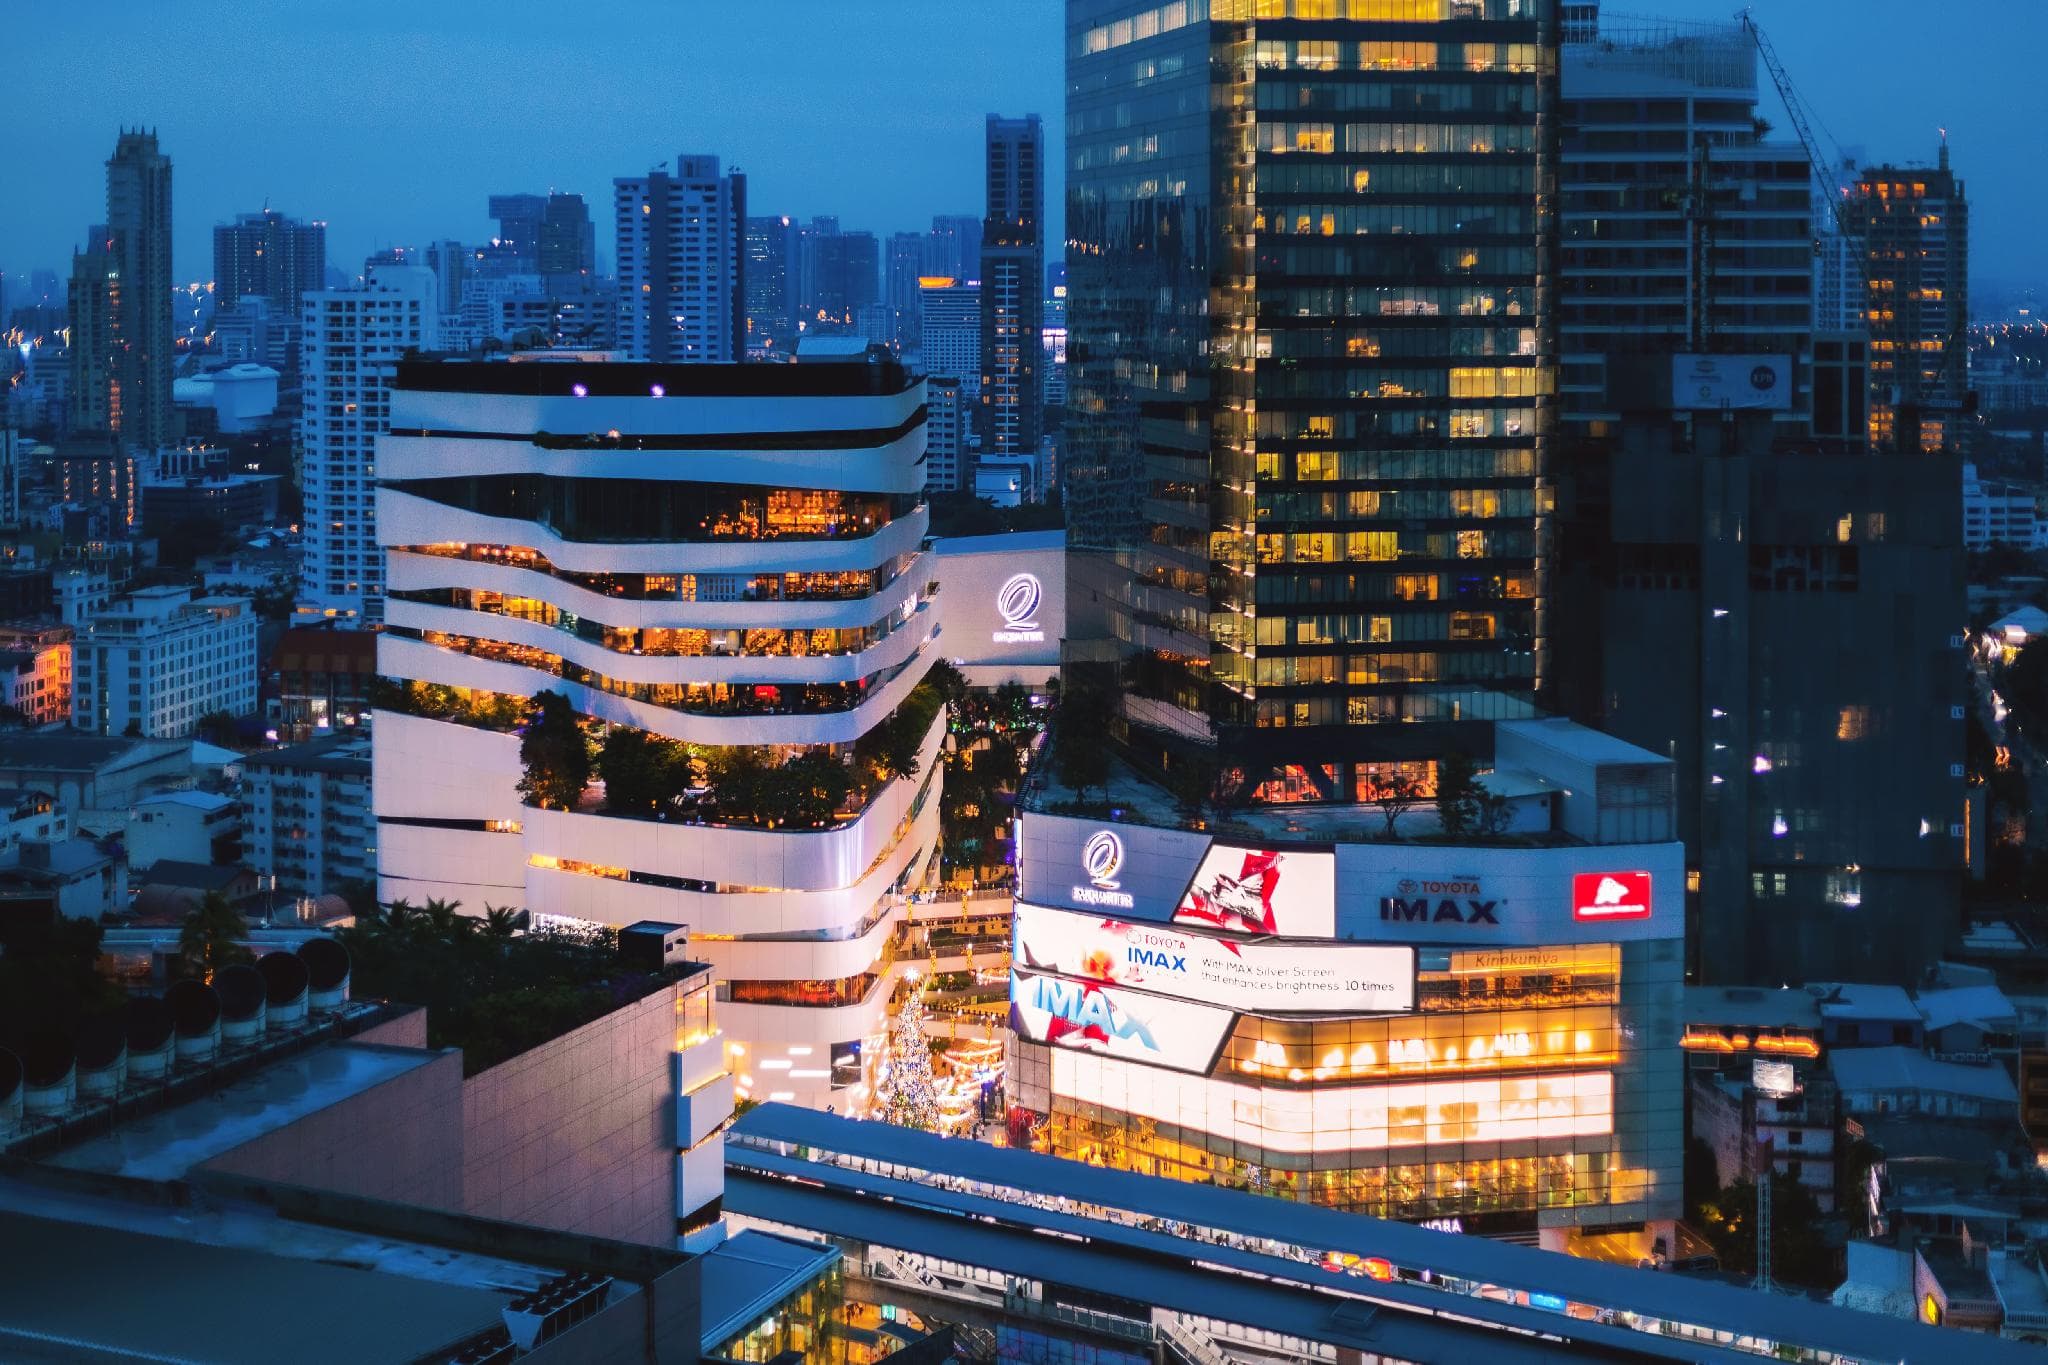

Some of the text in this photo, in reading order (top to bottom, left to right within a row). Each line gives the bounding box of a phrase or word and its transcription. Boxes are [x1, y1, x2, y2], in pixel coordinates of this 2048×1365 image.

[1422, 881, 1480, 894] TOYOTA
[1380, 897, 1500, 924] IMAX
[1145, 934, 1186, 949] TOYOTA
[1128, 946, 1186, 973] IMAX
[1202, 958, 1335, 977] With IMAX Silver Screen
[1475, 951, 1558, 967] Kinokuniya
[1202, 971, 1395, 994] that enhances brightness 10 times
[1032, 977, 1160, 1052] IMAX
